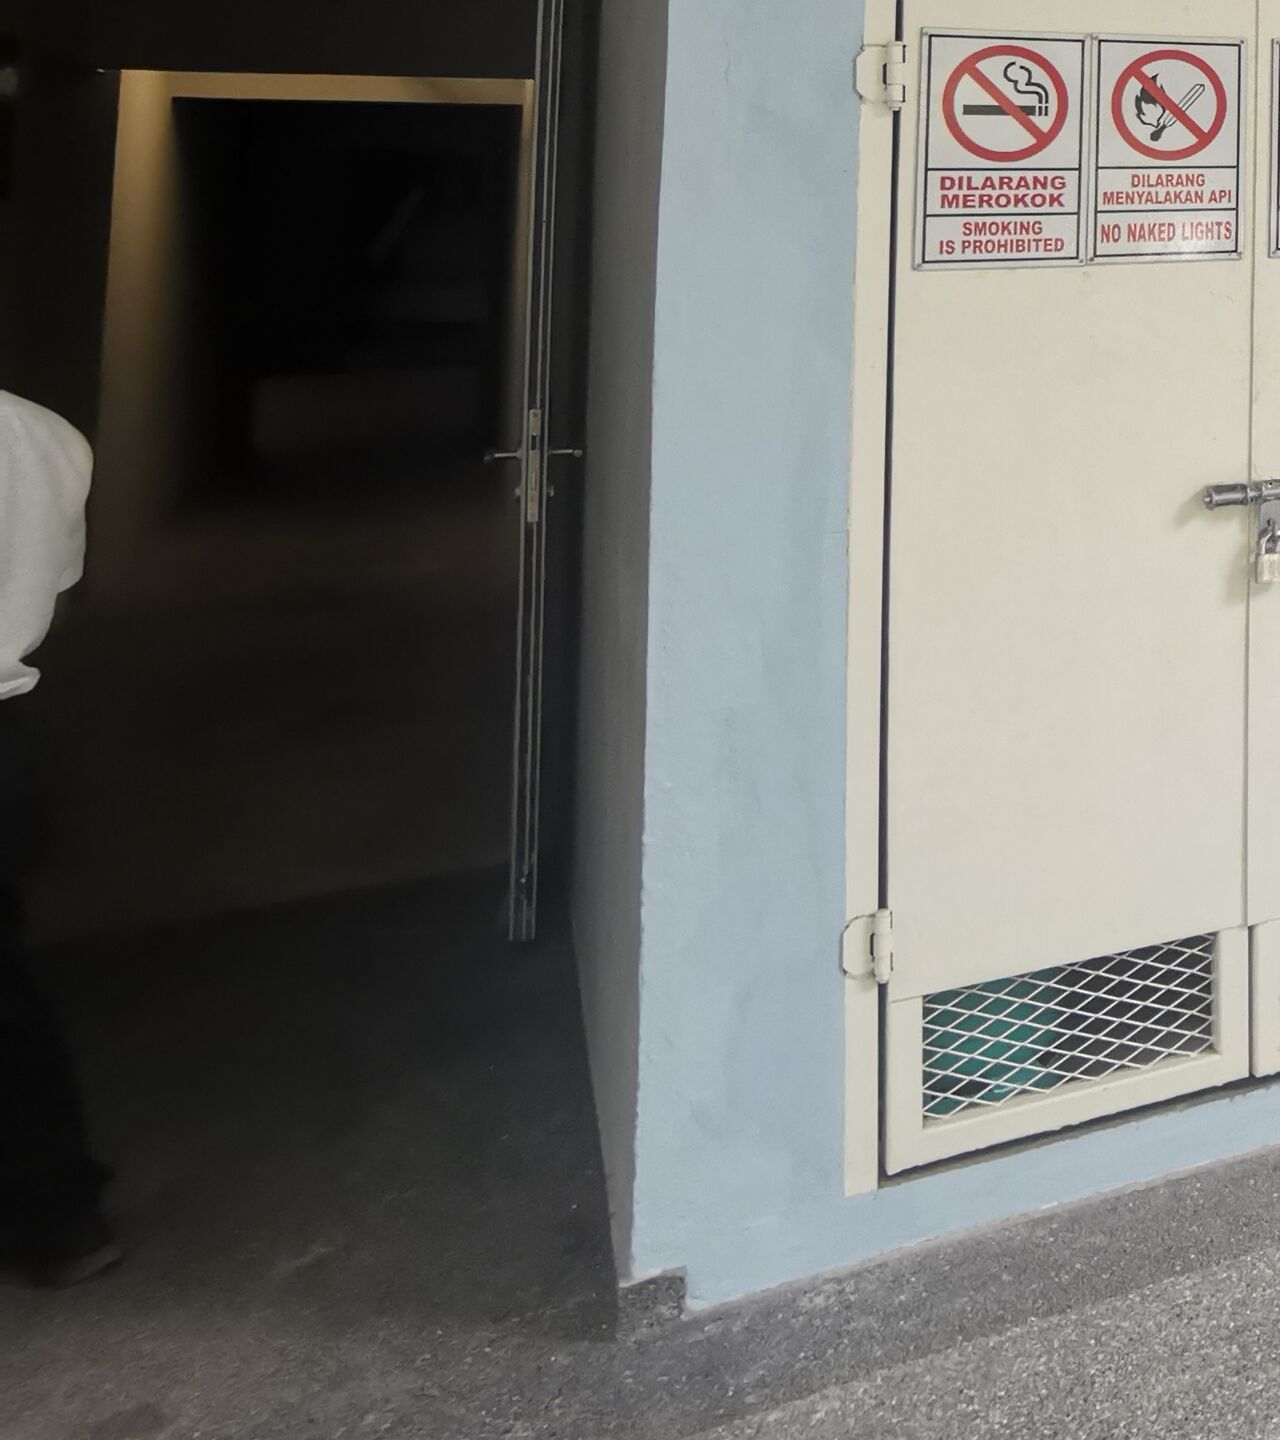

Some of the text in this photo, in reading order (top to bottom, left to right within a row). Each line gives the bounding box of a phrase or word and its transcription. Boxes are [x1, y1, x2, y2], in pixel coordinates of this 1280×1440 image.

[939, 175, 1067, 192] DILARANG
[1130, 173, 1206, 189] DILARANG
[940, 192, 1066, 209] MEROKOK
[1102, 189, 1233, 206] MENYALAKAN API
[962, 220, 1043, 237] SMOKING
[1100, 220, 1234, 244] NO NAKED LIGHTS
[939, 237, 1065, 255] IS PROHIBITED
